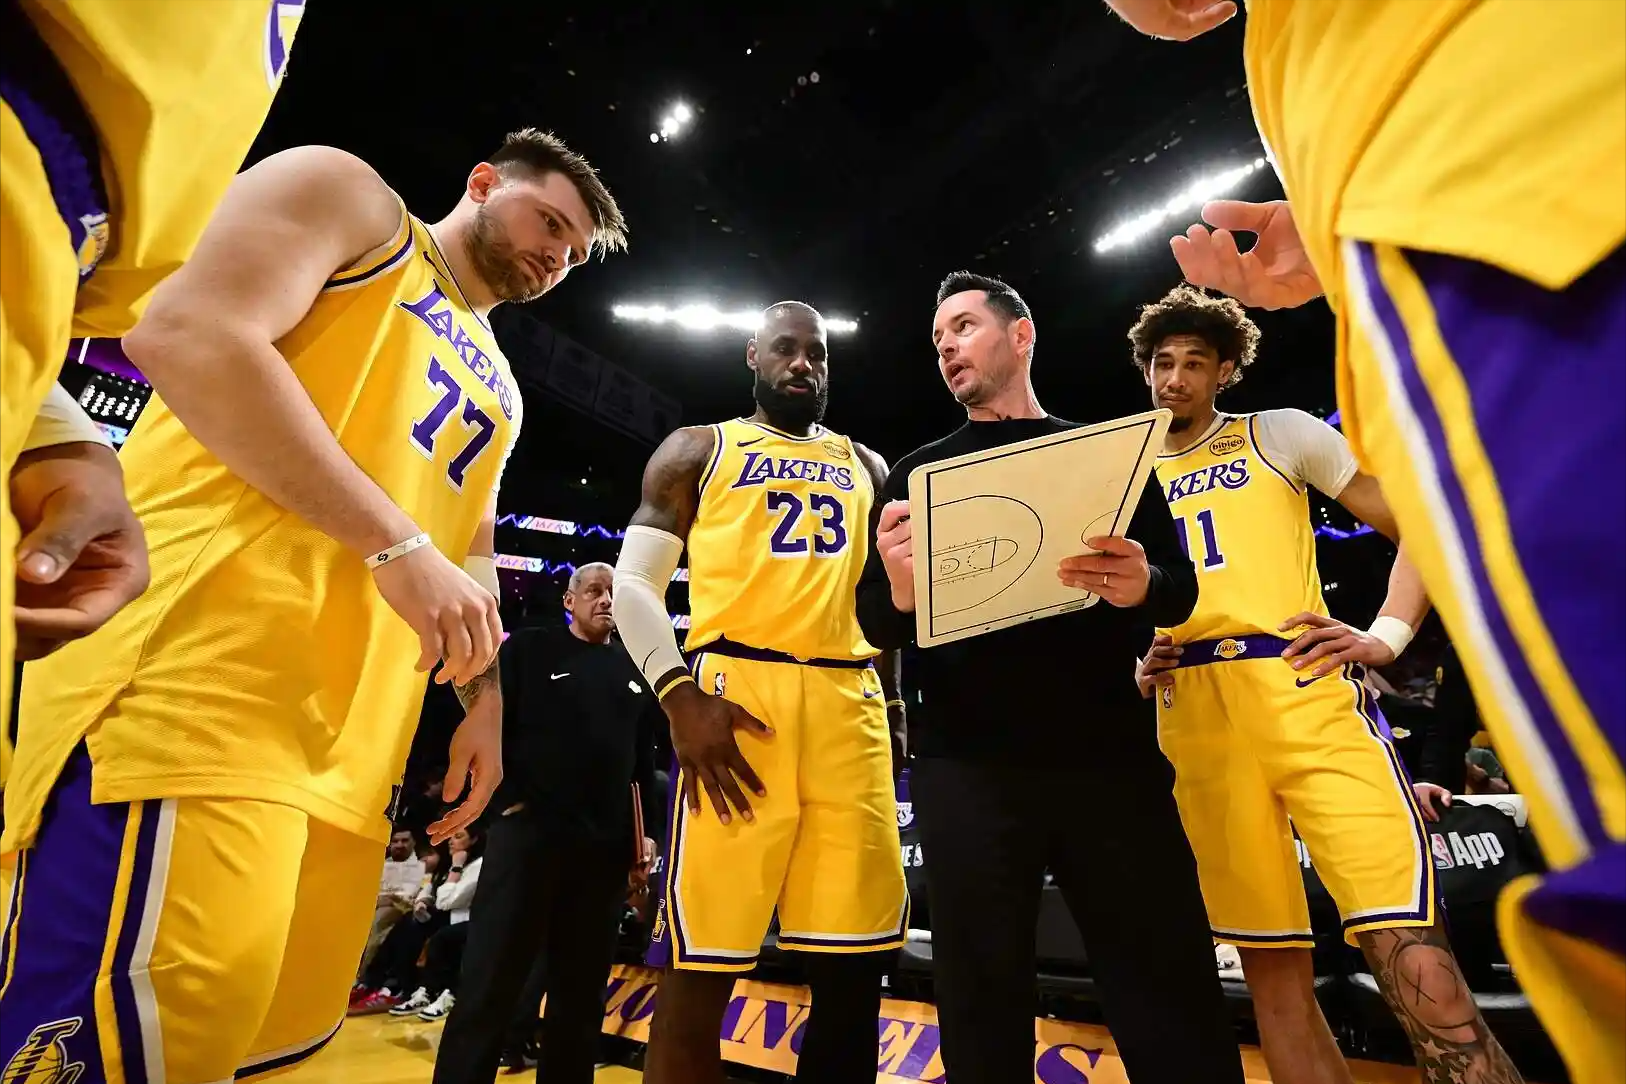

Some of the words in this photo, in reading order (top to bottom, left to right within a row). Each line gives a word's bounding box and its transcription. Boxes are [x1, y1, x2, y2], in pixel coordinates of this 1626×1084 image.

[398, 278, 513, 421] LAKERS
[411, 355, 496, 489] 77
[1212, 439, 1243, 450] bibigo
[732, 452, 855, 491] LAKERS
[1160, 458, 1250, 502] KERS
[766, 490, 848, 555] 23
[1448, 832, 1504, 869] App
